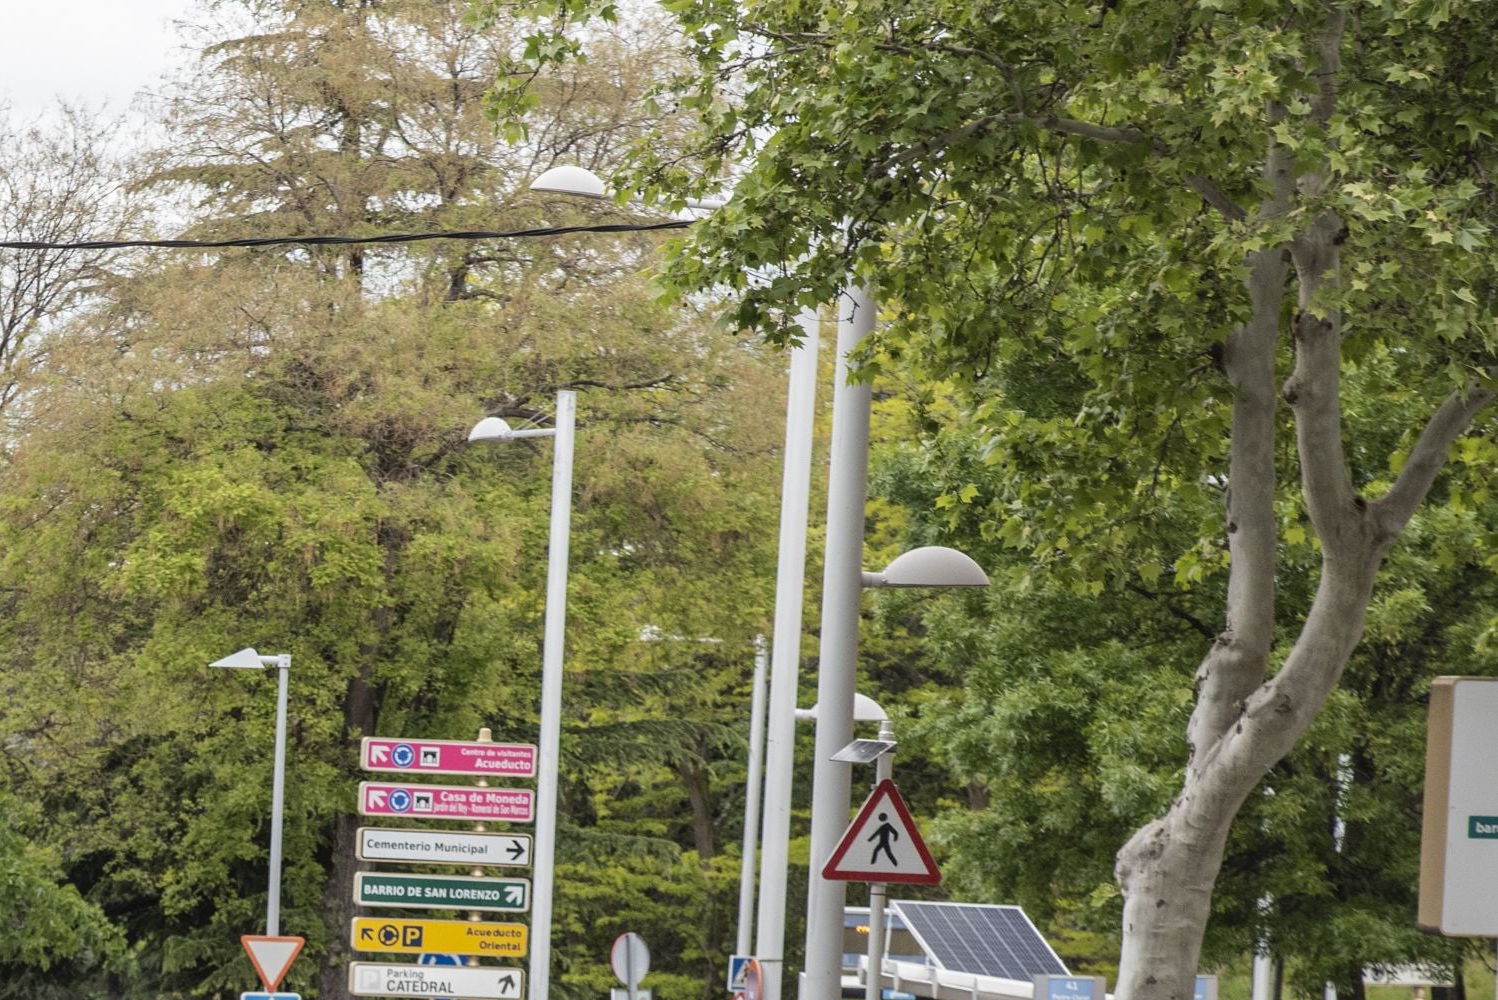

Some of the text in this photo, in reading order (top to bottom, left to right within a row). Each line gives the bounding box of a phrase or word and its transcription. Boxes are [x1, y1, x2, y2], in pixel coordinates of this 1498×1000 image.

[475, 758, 531, 771] Acueducto
[440, 791, 528, 805] Casa de Moneda
[367, 839, 488, 855] Cementerio Municipal
[364, 884, 500, 901] BARRIO DE SAN LORENZO
[466, 927, 522, 938] Acueducto
[479, 941, 521, 951] Oriental
[387, 968, 424, 981] Parking
[386, 980, 454, 994] CATEDRAL
